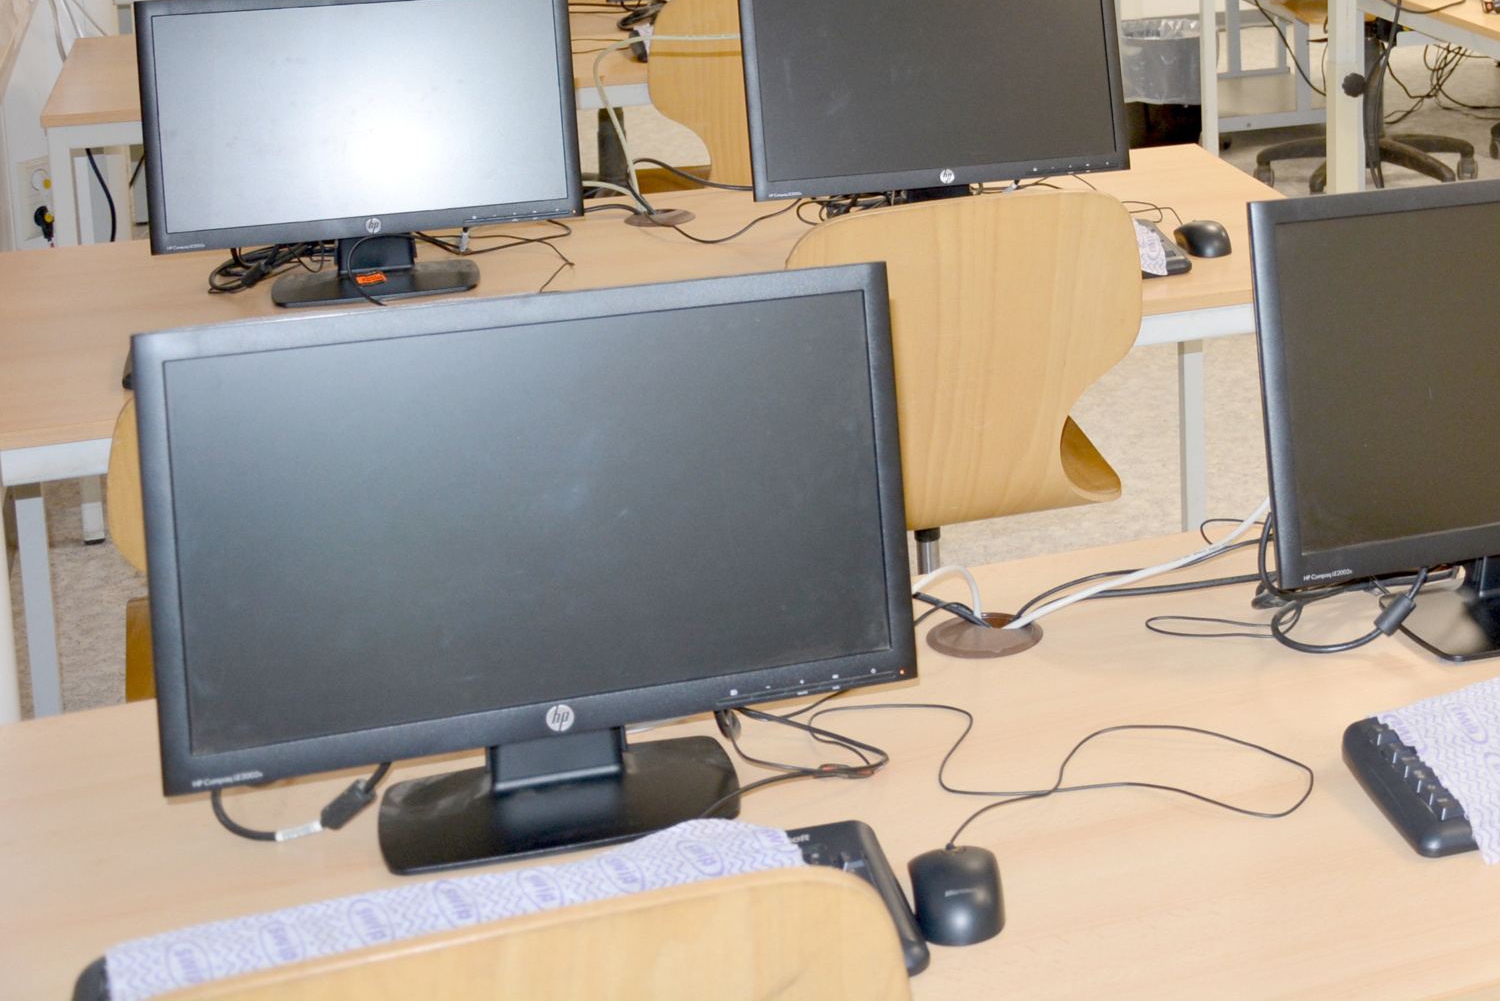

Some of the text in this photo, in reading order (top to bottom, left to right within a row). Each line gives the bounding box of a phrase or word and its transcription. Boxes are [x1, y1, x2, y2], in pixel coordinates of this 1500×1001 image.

[940, 169, 954, 184] hp
[366, 218, 381, 233] hp
[548, 704, 573, 732] hp
[192, 779, 203, 788] HP
[203, 776, 233, 786] Compaq
